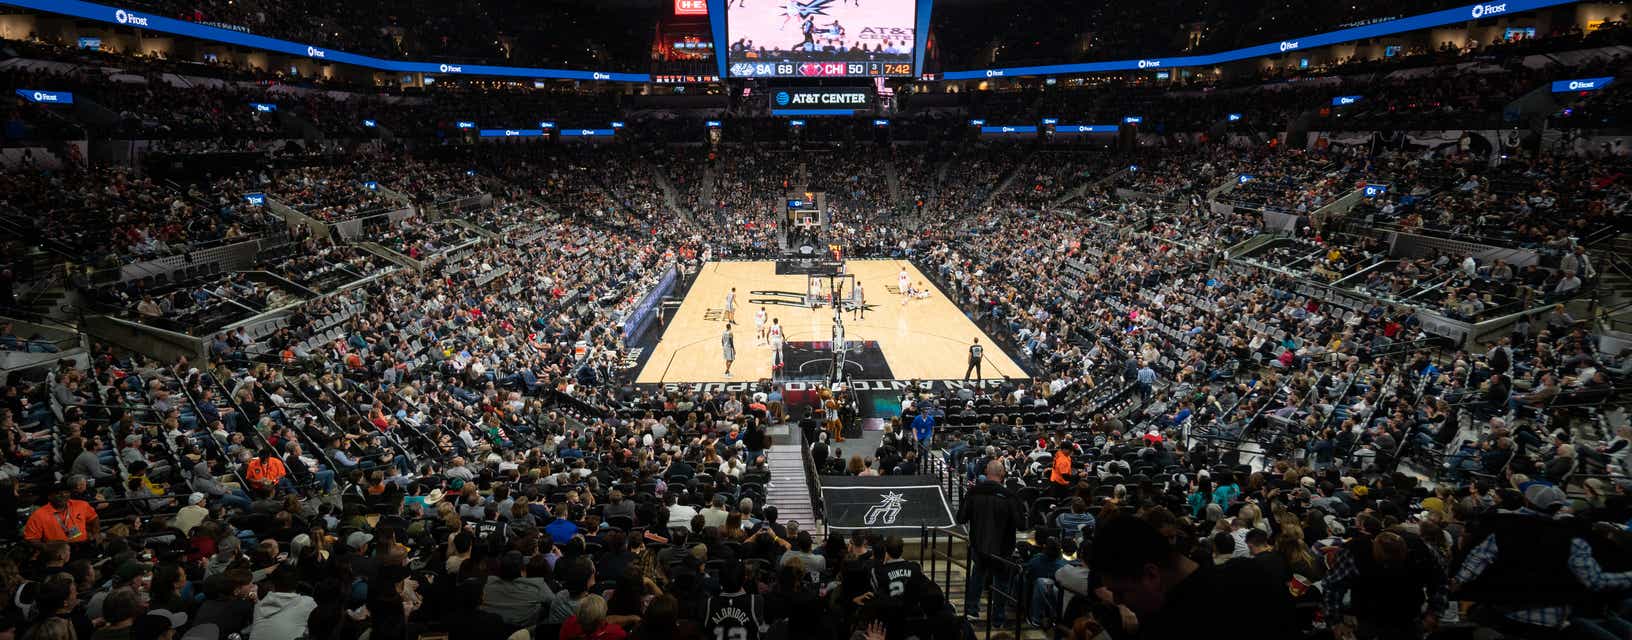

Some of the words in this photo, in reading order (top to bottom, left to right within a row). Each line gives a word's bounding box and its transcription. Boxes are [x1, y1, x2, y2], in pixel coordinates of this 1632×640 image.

[682, 1, 705, 9] H-E-
[1484, 3, 1506, 15] Frost
[127, 13, 148, 26] Frost
[1286, 42, 1299, 50] Frost
[313, 49, 325, 58] Frost
[757, 65, 771, 75] SA
[777, 65, 793, 74] 68
[825, 65, 844, 74] CHI
[849, 65, 863, 74] 50
[885, 65, 910, 74] 7:42
[1577, 81, 1594, 89] Frost
[42, 93, 57, 101] Frost
[792, 94, 820, 104] AT&T
[821, 94, 866, 104] CENTER
[888, 569, 912, 581] DUNCAN
[889, 581, 904, 597] 2
[711, 607, 749, 625] ALDRIDGE
